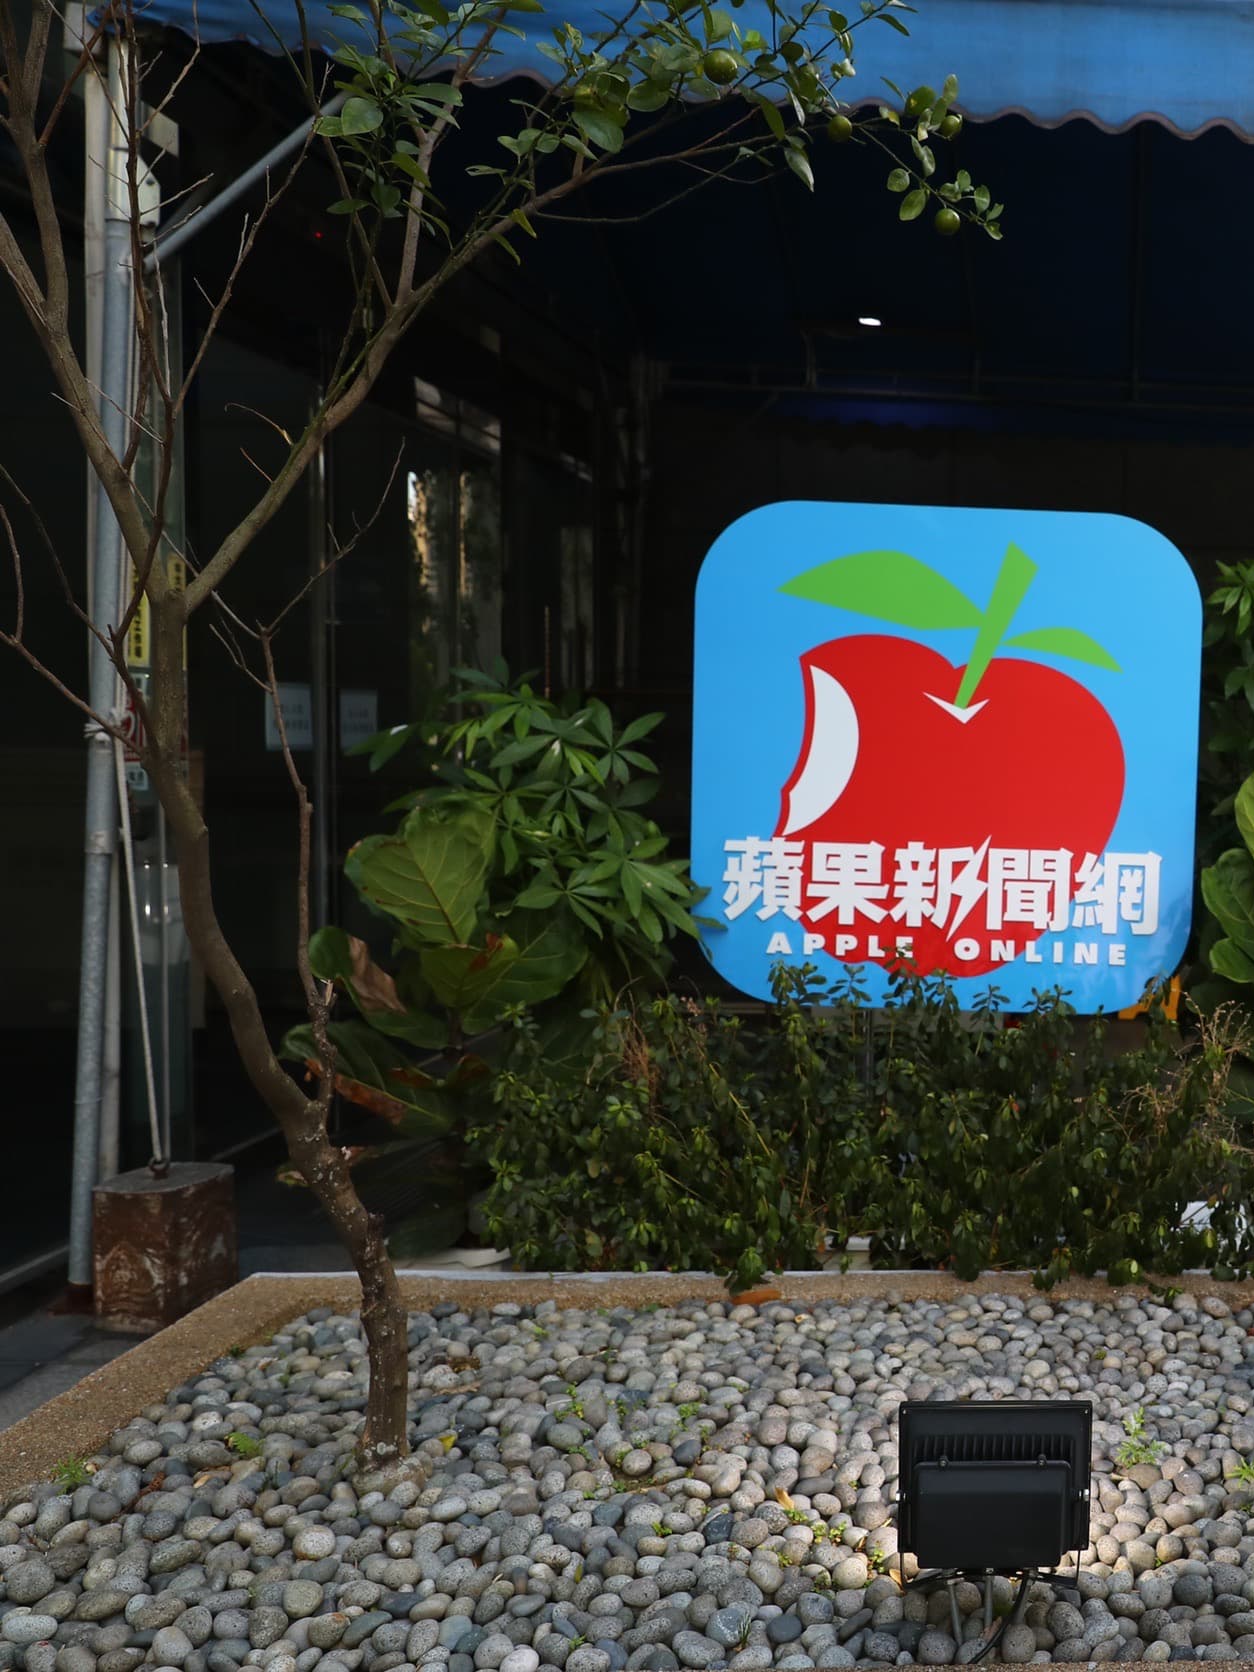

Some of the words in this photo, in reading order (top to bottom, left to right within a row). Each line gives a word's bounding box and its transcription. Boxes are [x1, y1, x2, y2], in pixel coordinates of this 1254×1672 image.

[723, 835, 1162, 941] 蘋果新聞網
[766, 932, 913, 959] APPLE
[954, 938, 1126, 966] ONLINE
